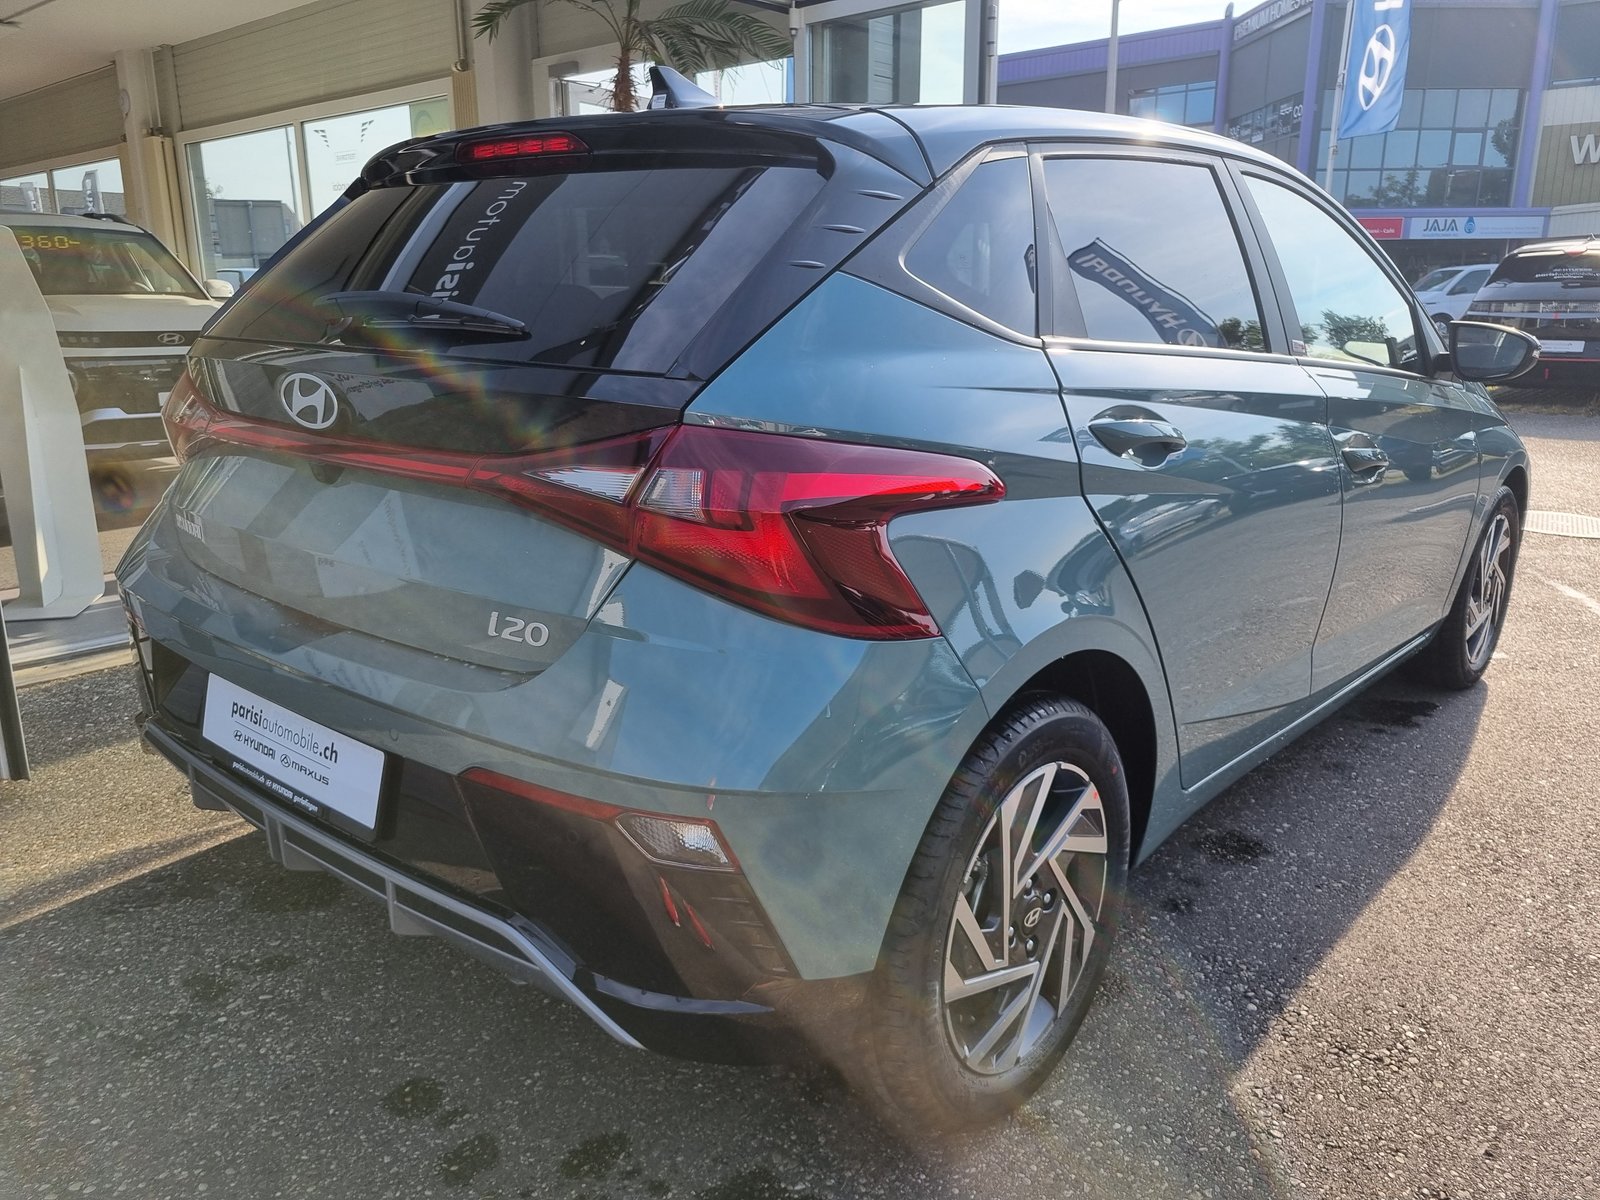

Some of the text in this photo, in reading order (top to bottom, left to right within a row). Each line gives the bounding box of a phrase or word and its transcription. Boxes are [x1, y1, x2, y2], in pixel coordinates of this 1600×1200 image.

[1423, 218, 1458, 232] JAJA
[231, 701, 339, 764] parisiautomobile.ch
[243, 734, 330, 786] HYUNDAI MAXUS
